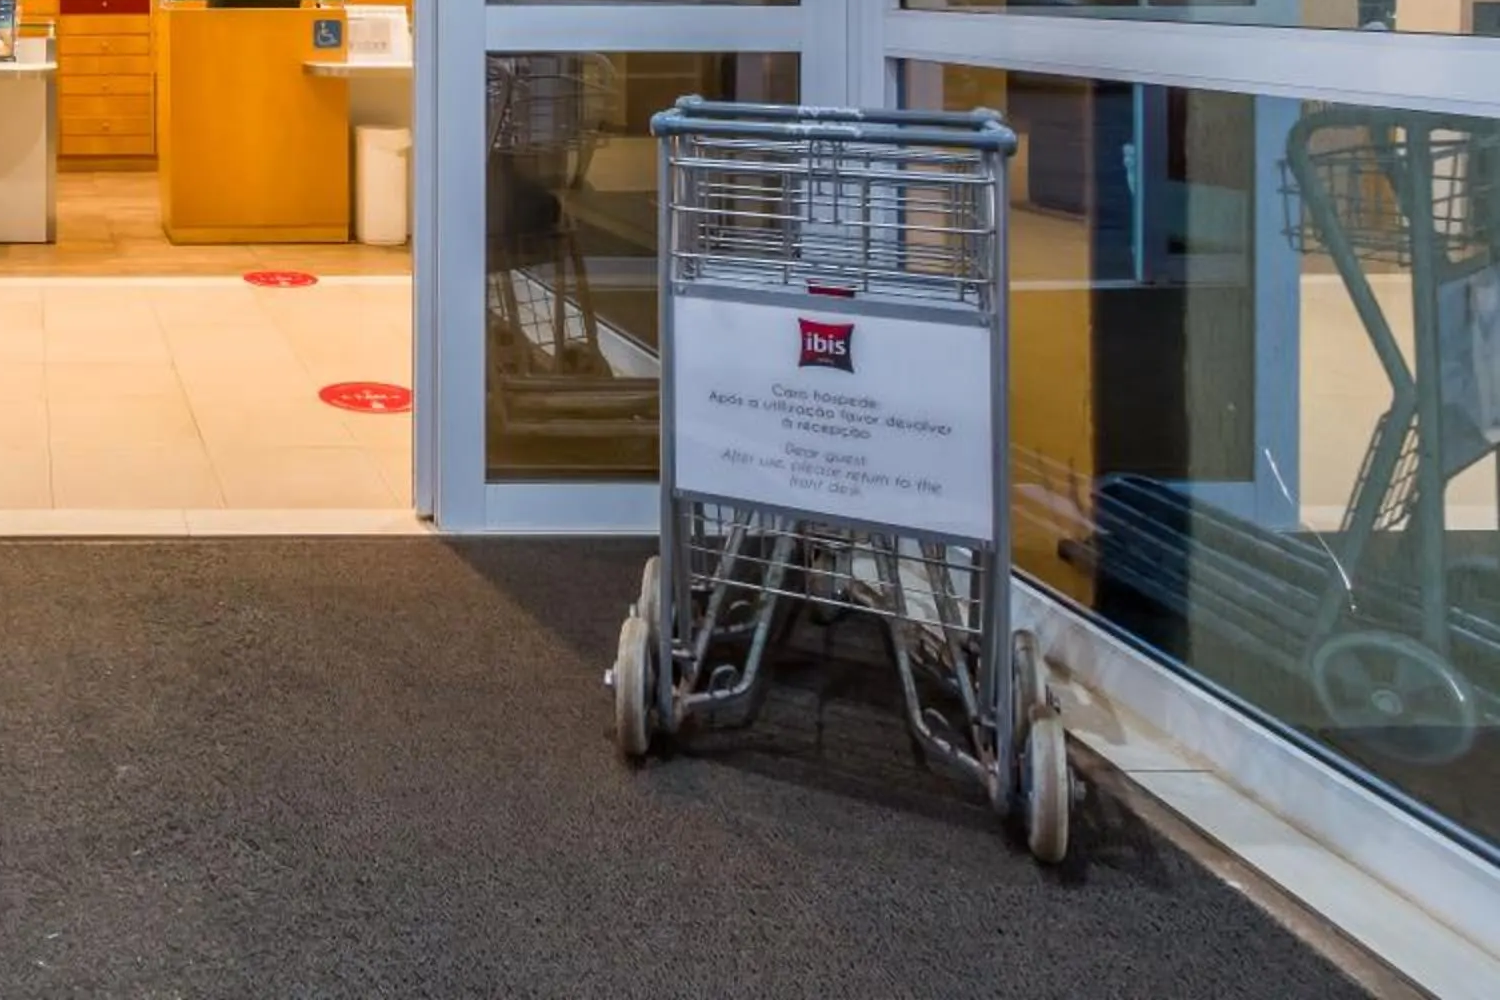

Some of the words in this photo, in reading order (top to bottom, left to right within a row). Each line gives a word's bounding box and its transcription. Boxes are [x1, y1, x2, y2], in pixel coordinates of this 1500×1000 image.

[806, 332, 846, 355] ibis
[771, 382, 808, 399] Caro
[748, 398, 759, 409] a
[840, 408, 879, 425] favor
[886, 415, 953, 436] devolver
[895, 475, 911, 489] to
